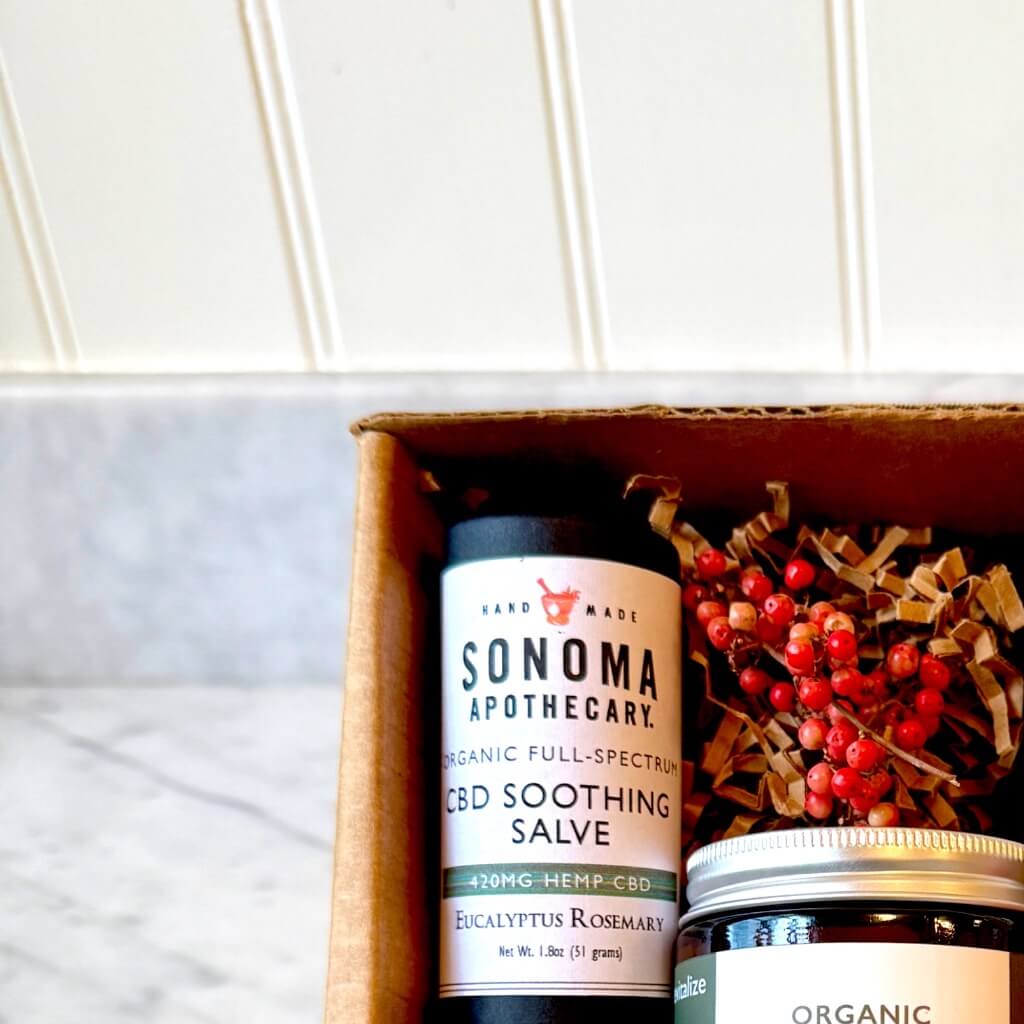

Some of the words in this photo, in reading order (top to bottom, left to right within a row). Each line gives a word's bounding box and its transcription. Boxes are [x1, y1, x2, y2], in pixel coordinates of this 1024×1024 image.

[482, 602, 530, 616] HAND
[586, 605, 637, 623] MADE
[462, 637, 658, 701] SONOMA
[443, 746, 517, 770] ORGANIC
[529, 746, 678, 777] FULL-SPECTRUM
[446, 784, 490, 814] CBD
[503, 782, 670, 818] SOOTHING
[511, 818, 610, 846] SALVE
[470, 873, 533, 889] 420MG
[544, 873, 604, 889] HEMP
[614, 875, 651, 892] CBD
[499, 945, 514, 958] Net
[518, 945, 535, 958] Wt.
[539, 945, 564, 958] 1.8oz
[570, 945, 586, 960] (51
[592, 946, 623, 961] grams)
